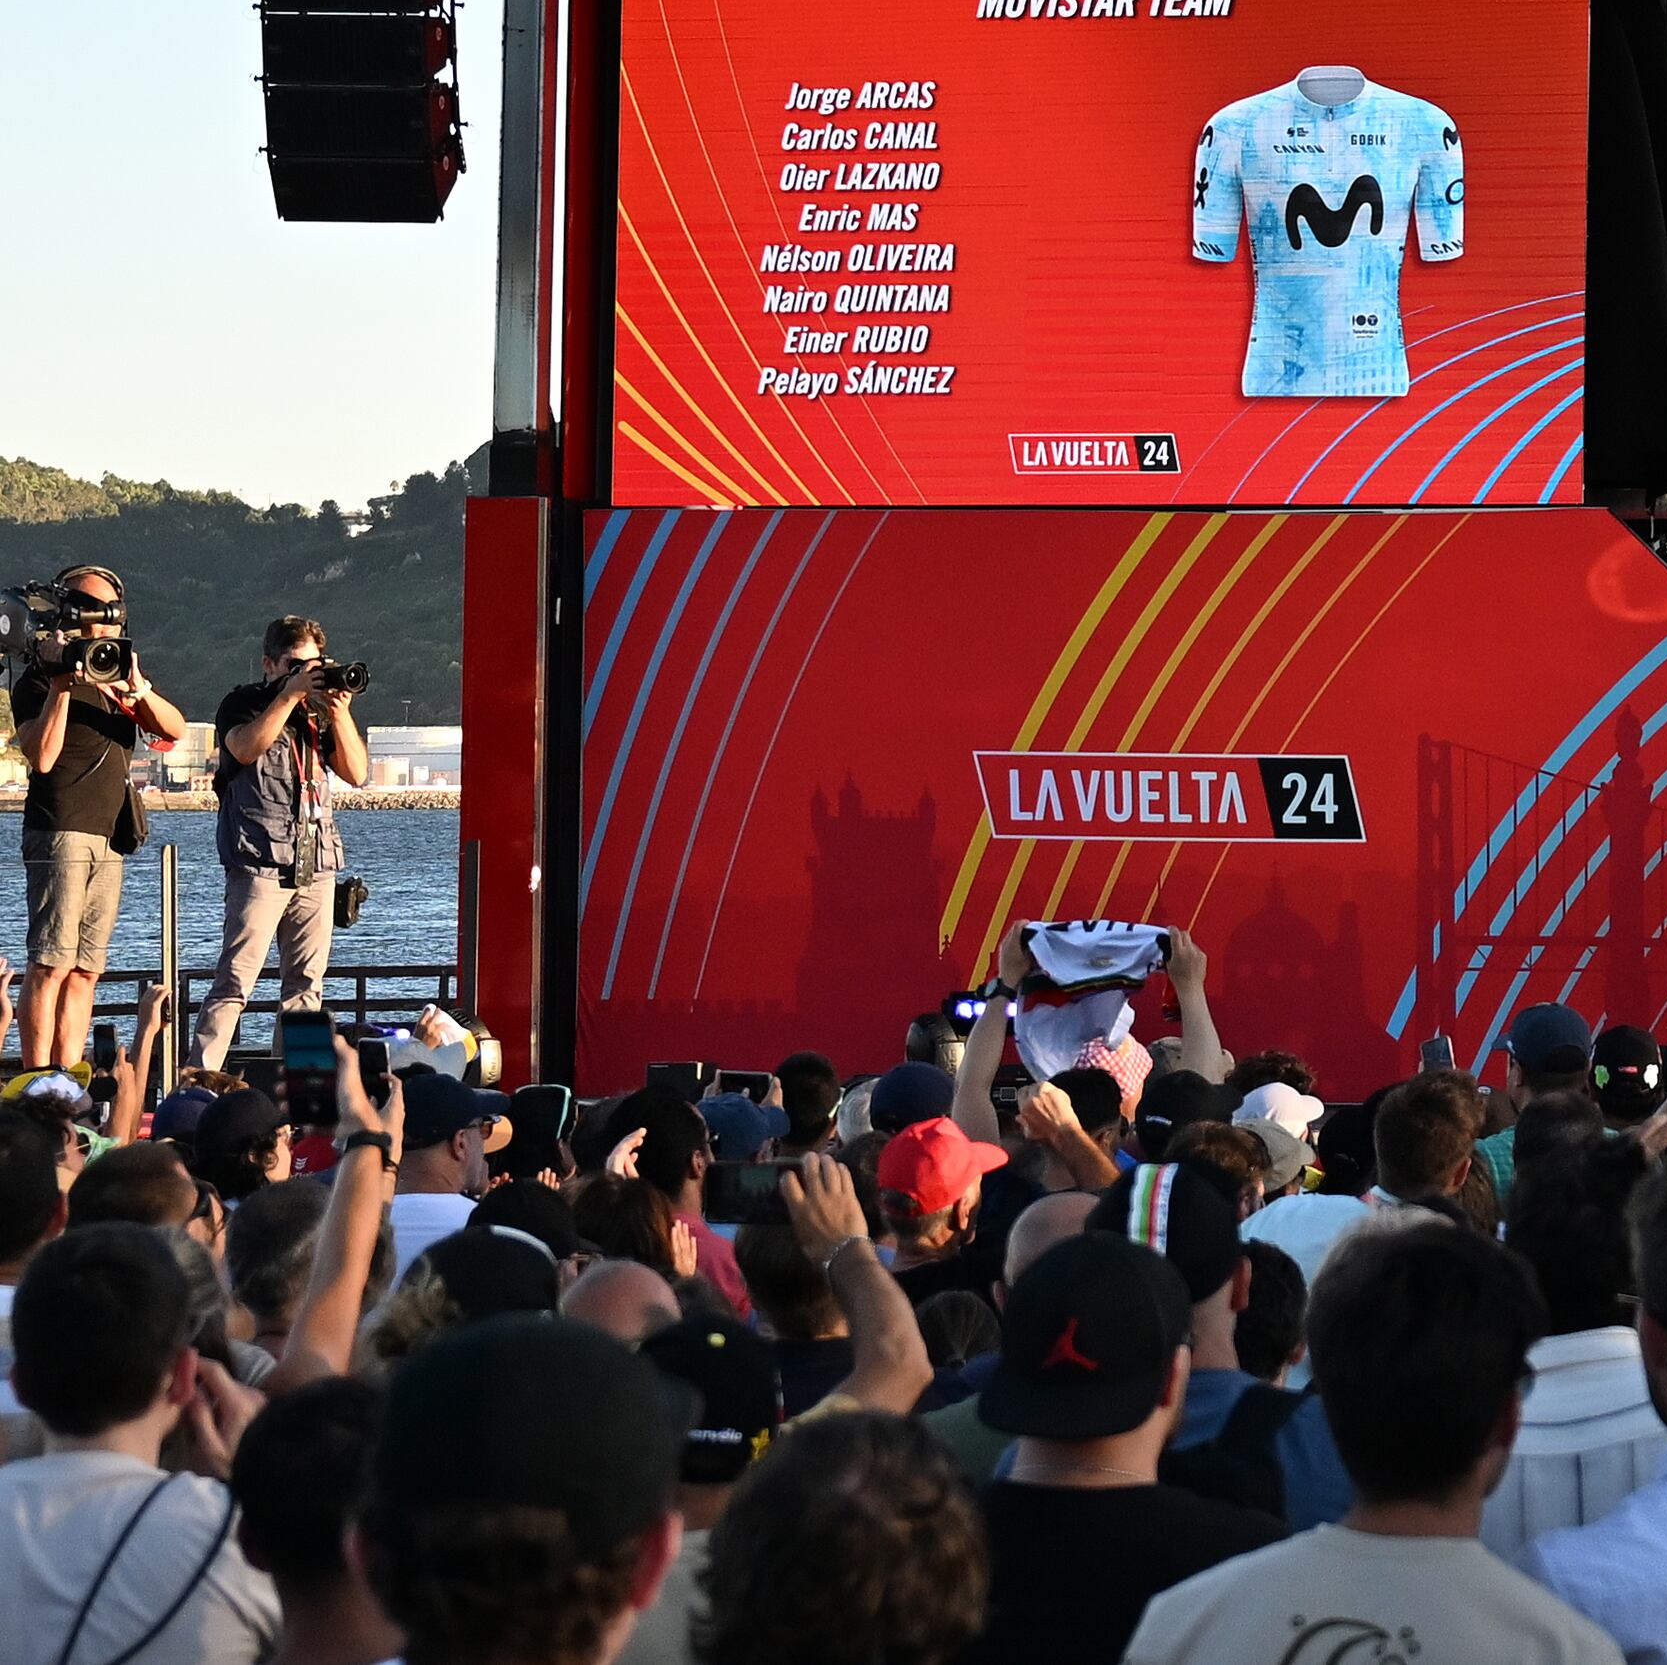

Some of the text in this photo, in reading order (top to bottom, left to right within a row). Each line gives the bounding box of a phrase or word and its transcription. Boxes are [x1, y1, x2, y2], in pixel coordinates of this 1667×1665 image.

[784, 80, 936, 115] Jorge ARCAS
[780, 121, 938, 151] Carlos CANAL
[1350, 134, 1387, 146] GOBIK
[779, 162, 941, 191] Oier LAZKANO
[798, 202, 920, 232] Enric MAS
[759, 243, 954, 273] Nélson OLIVEIRA
[762, 284, 950, 315] Nairo QUINTANA
[783, 325, 929, 354] Einer RUBIO
[757, 359, 955, 401] Pelayo SÁNCHEZ
[1023, 440, 1170, 467] LA VUELTA 24
[1008, 769, 1339, 824] LA VUELTA 24
